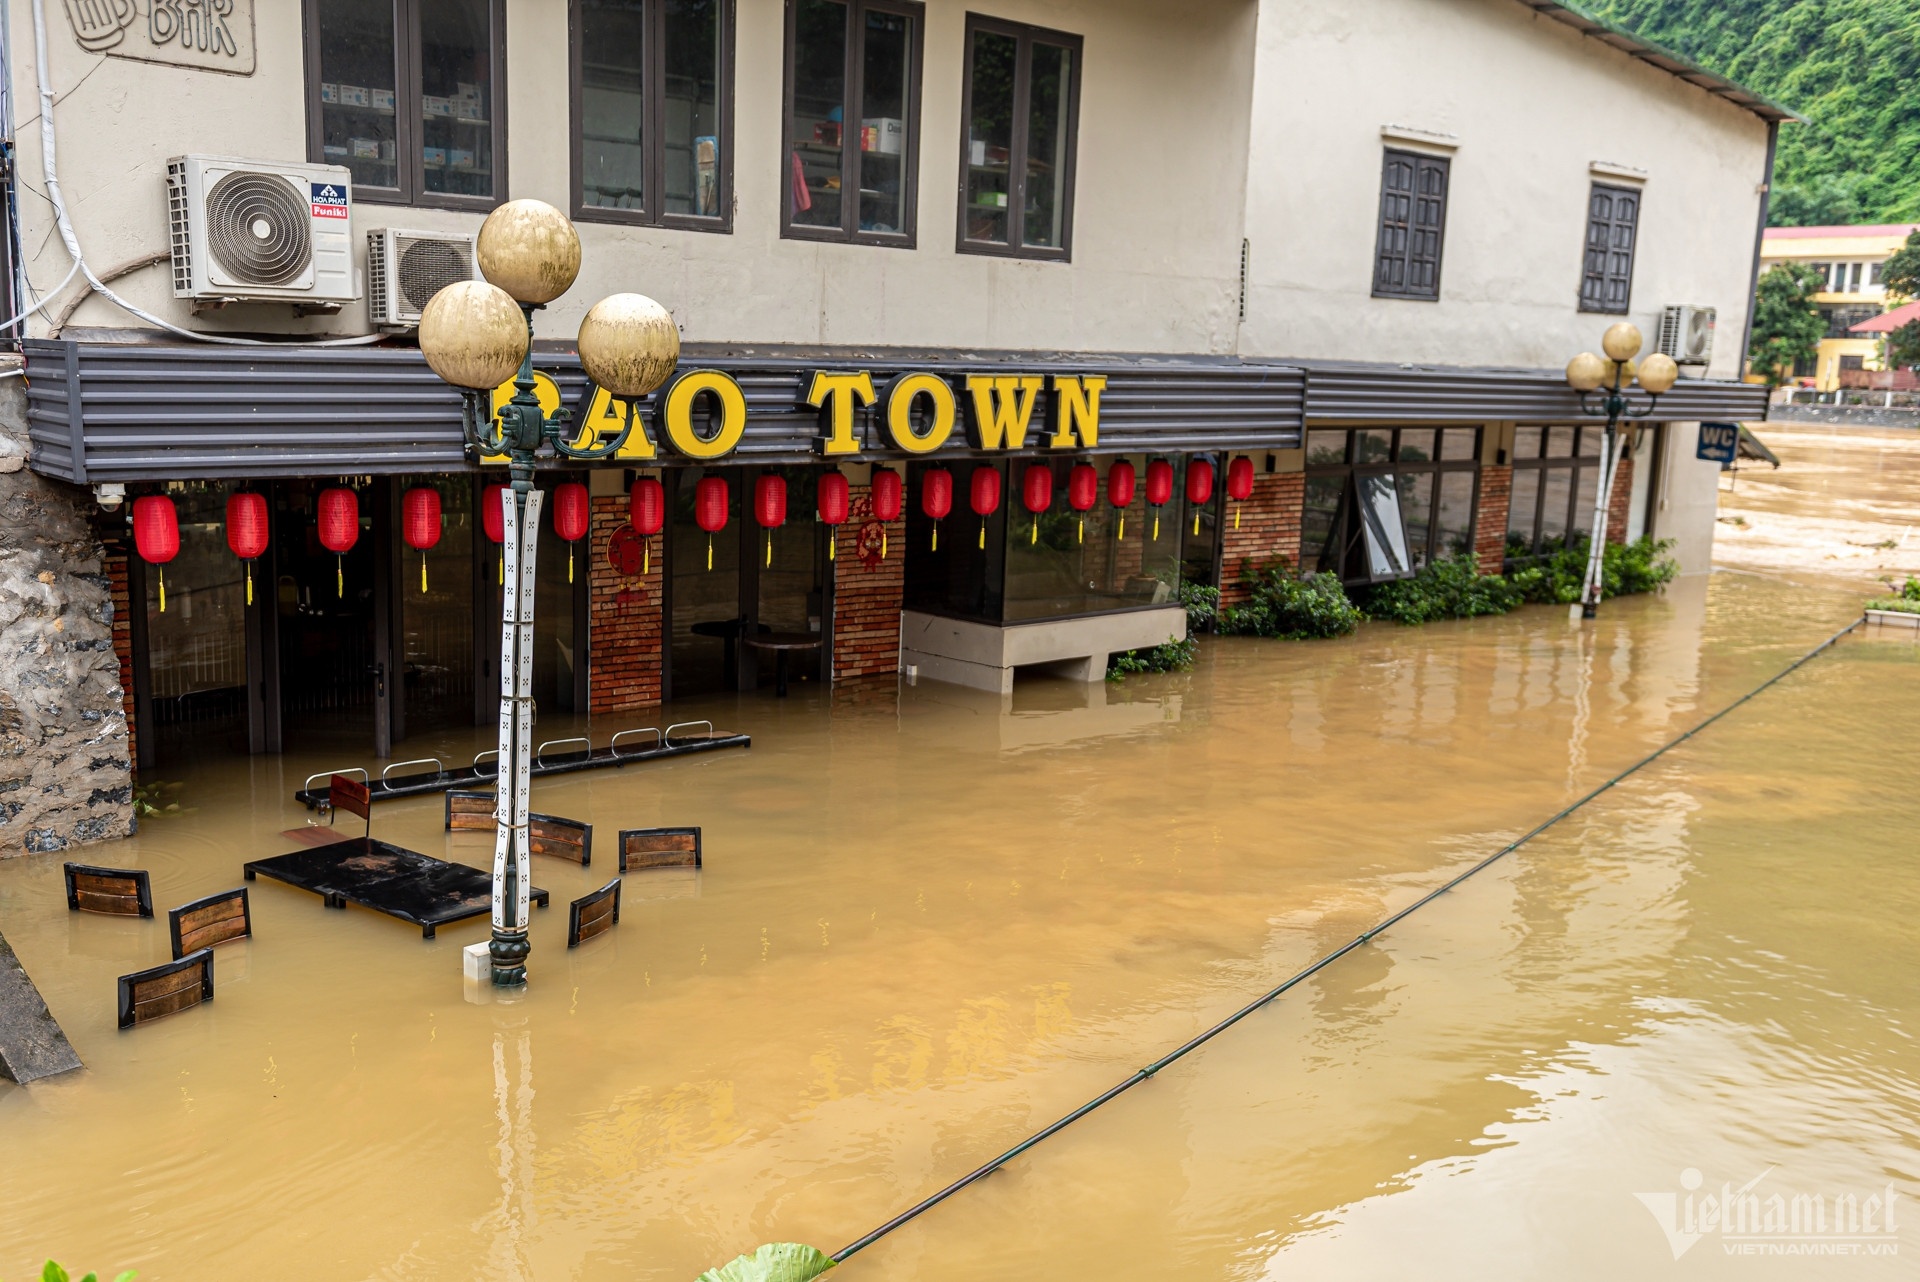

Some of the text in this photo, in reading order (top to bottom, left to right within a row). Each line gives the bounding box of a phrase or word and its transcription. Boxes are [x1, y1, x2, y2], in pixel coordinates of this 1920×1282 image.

[149, 0, 237, 57] BAR
[314, 206, 346, 216] Funiki
[805, 369, 1108, 456] TOWN
[1702, 426, 1734, 447] WC
